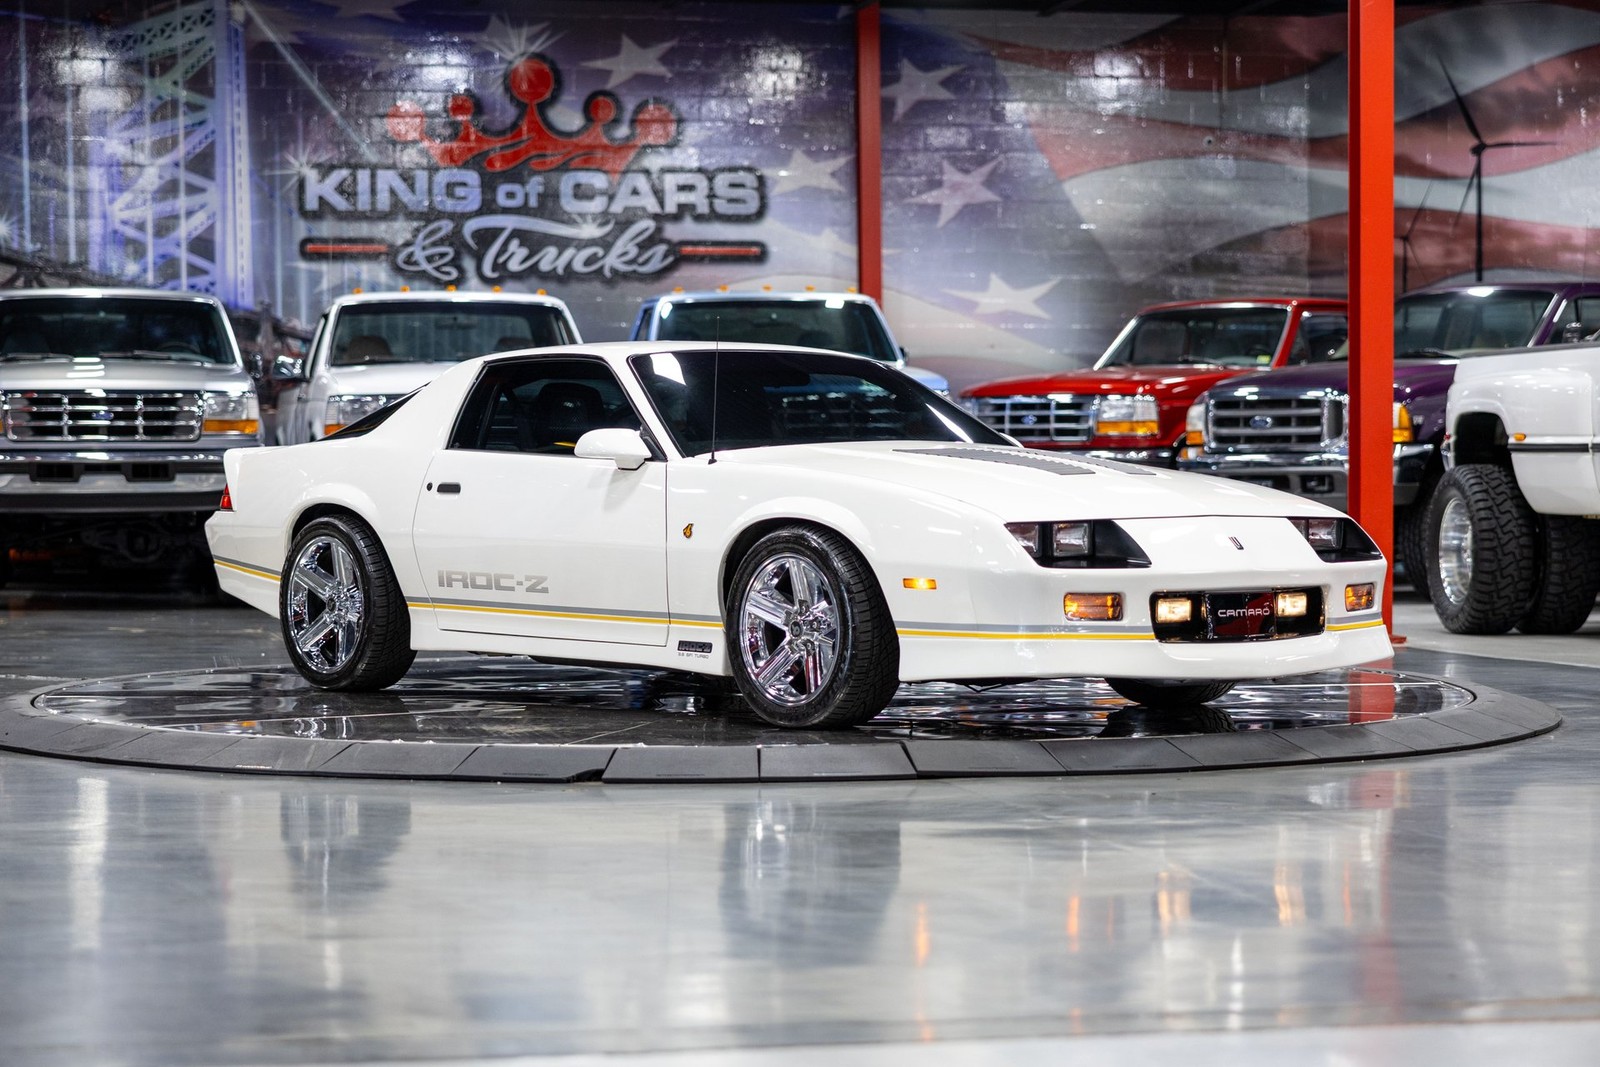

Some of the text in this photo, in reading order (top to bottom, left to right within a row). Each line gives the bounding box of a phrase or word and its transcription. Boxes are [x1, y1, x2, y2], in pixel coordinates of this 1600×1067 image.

[304, 168, 760, 215] KING of CARS
[396, 213, 676, 281] & Trucks
[438, 570, 549, 593] IROC-Z
[1217, 608, 1270, 617] CAMARO
